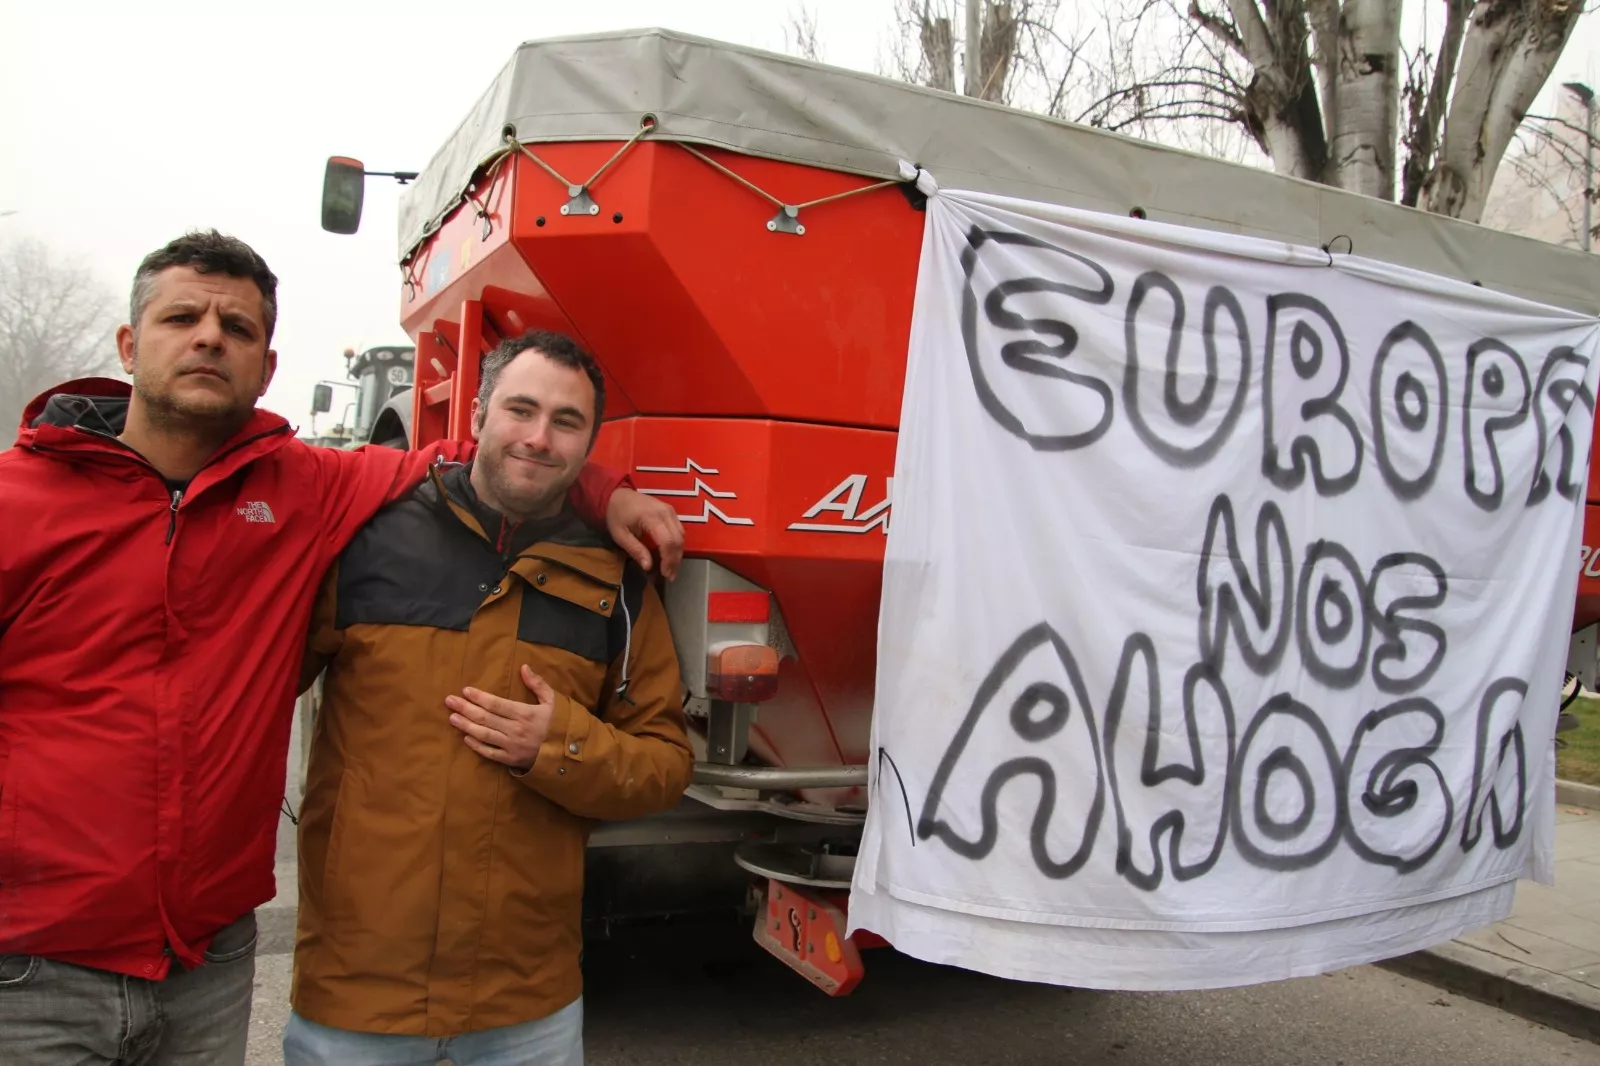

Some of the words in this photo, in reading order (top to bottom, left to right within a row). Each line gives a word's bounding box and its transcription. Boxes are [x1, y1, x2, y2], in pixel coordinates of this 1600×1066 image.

[390, 369, 404, 383] 50
[961, 223, 1595, 512] EUROPA
[236, 507, 263, 516] NORTH
[245, 515, 265, 523] FACE
[1196, 493, 1449, 693] NOS
[917, 621, 1526, 891] AHOGA
